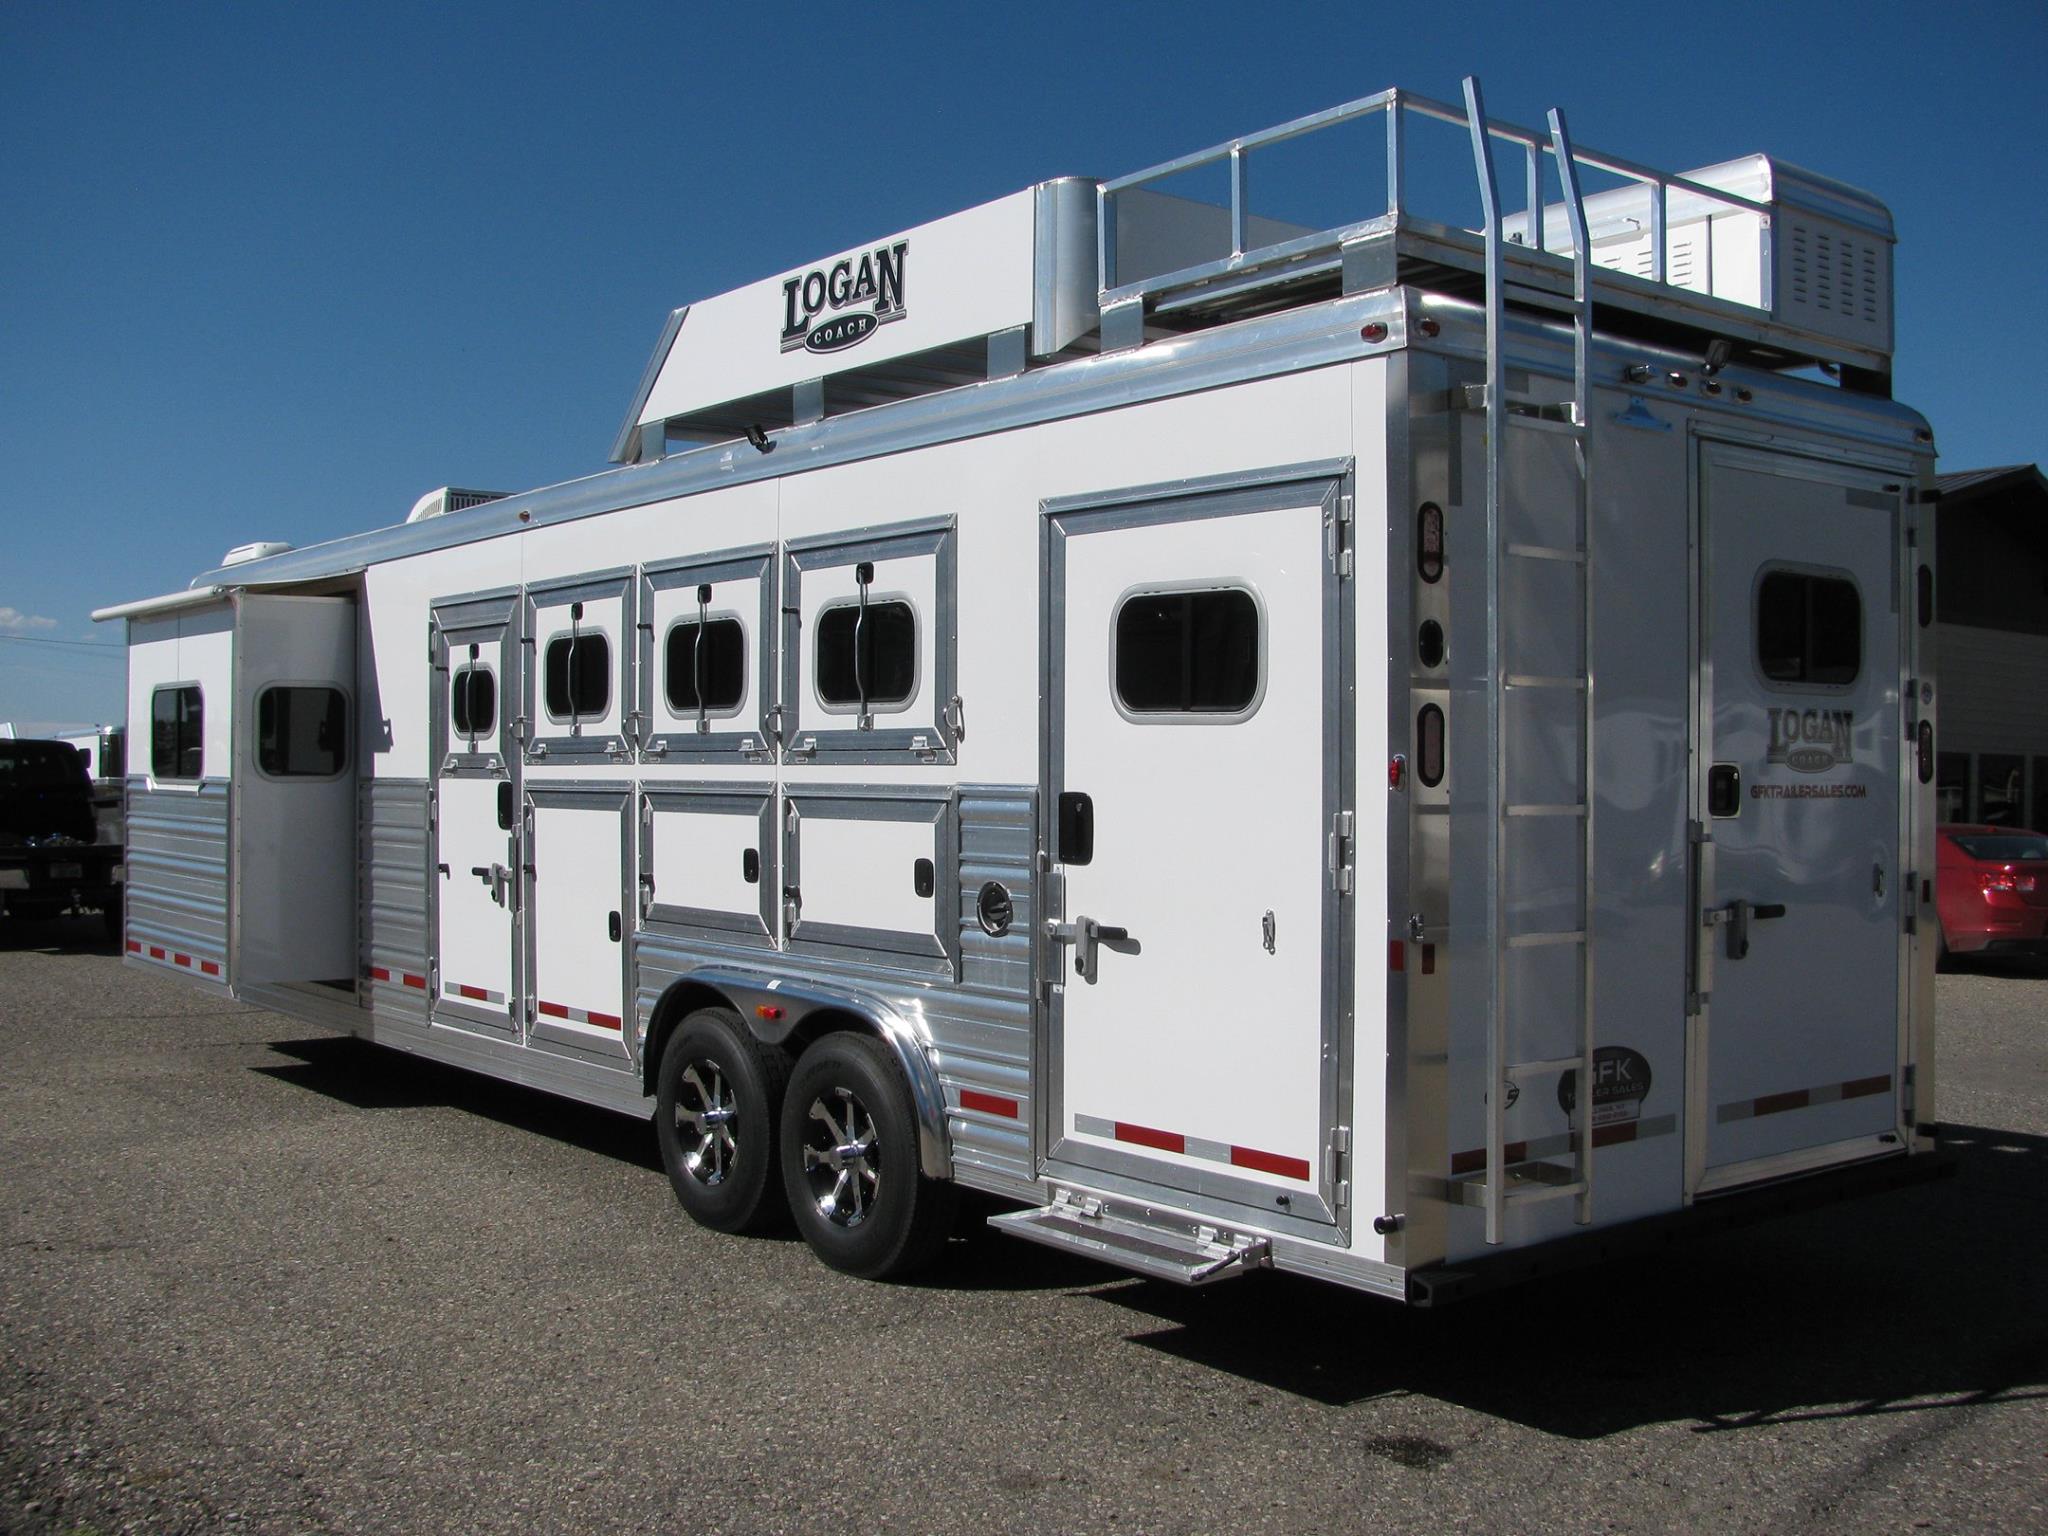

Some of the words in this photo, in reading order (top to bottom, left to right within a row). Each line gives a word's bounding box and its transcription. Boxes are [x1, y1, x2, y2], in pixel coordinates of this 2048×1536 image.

[781, 239, 909, 343] LOGAN
[814, 318, 868, 345] COACH
[1767, 707, 1853, 760] LOGAN
